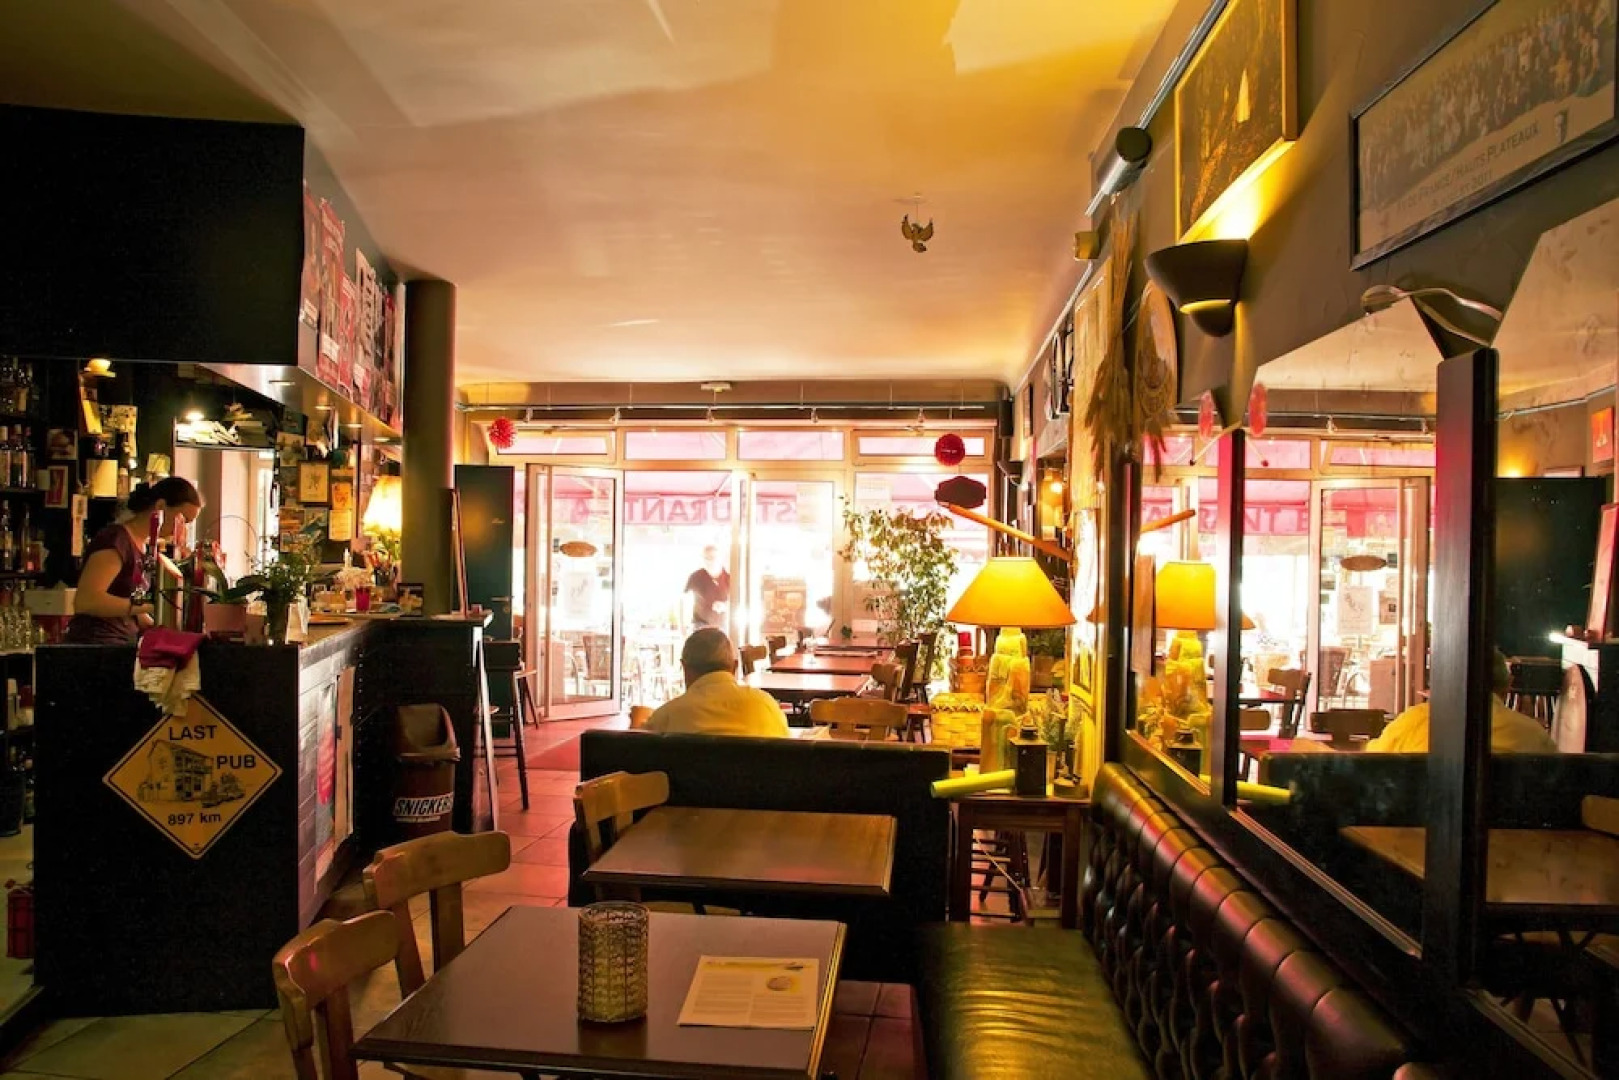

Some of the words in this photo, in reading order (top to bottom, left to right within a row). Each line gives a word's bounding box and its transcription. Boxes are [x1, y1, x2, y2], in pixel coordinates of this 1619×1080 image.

[168, 724, 218, 741] LAST
[216, 754, 257, 770] PUB
[167, 813, 194, 826] 897
[200, 812, 222, 824] km
